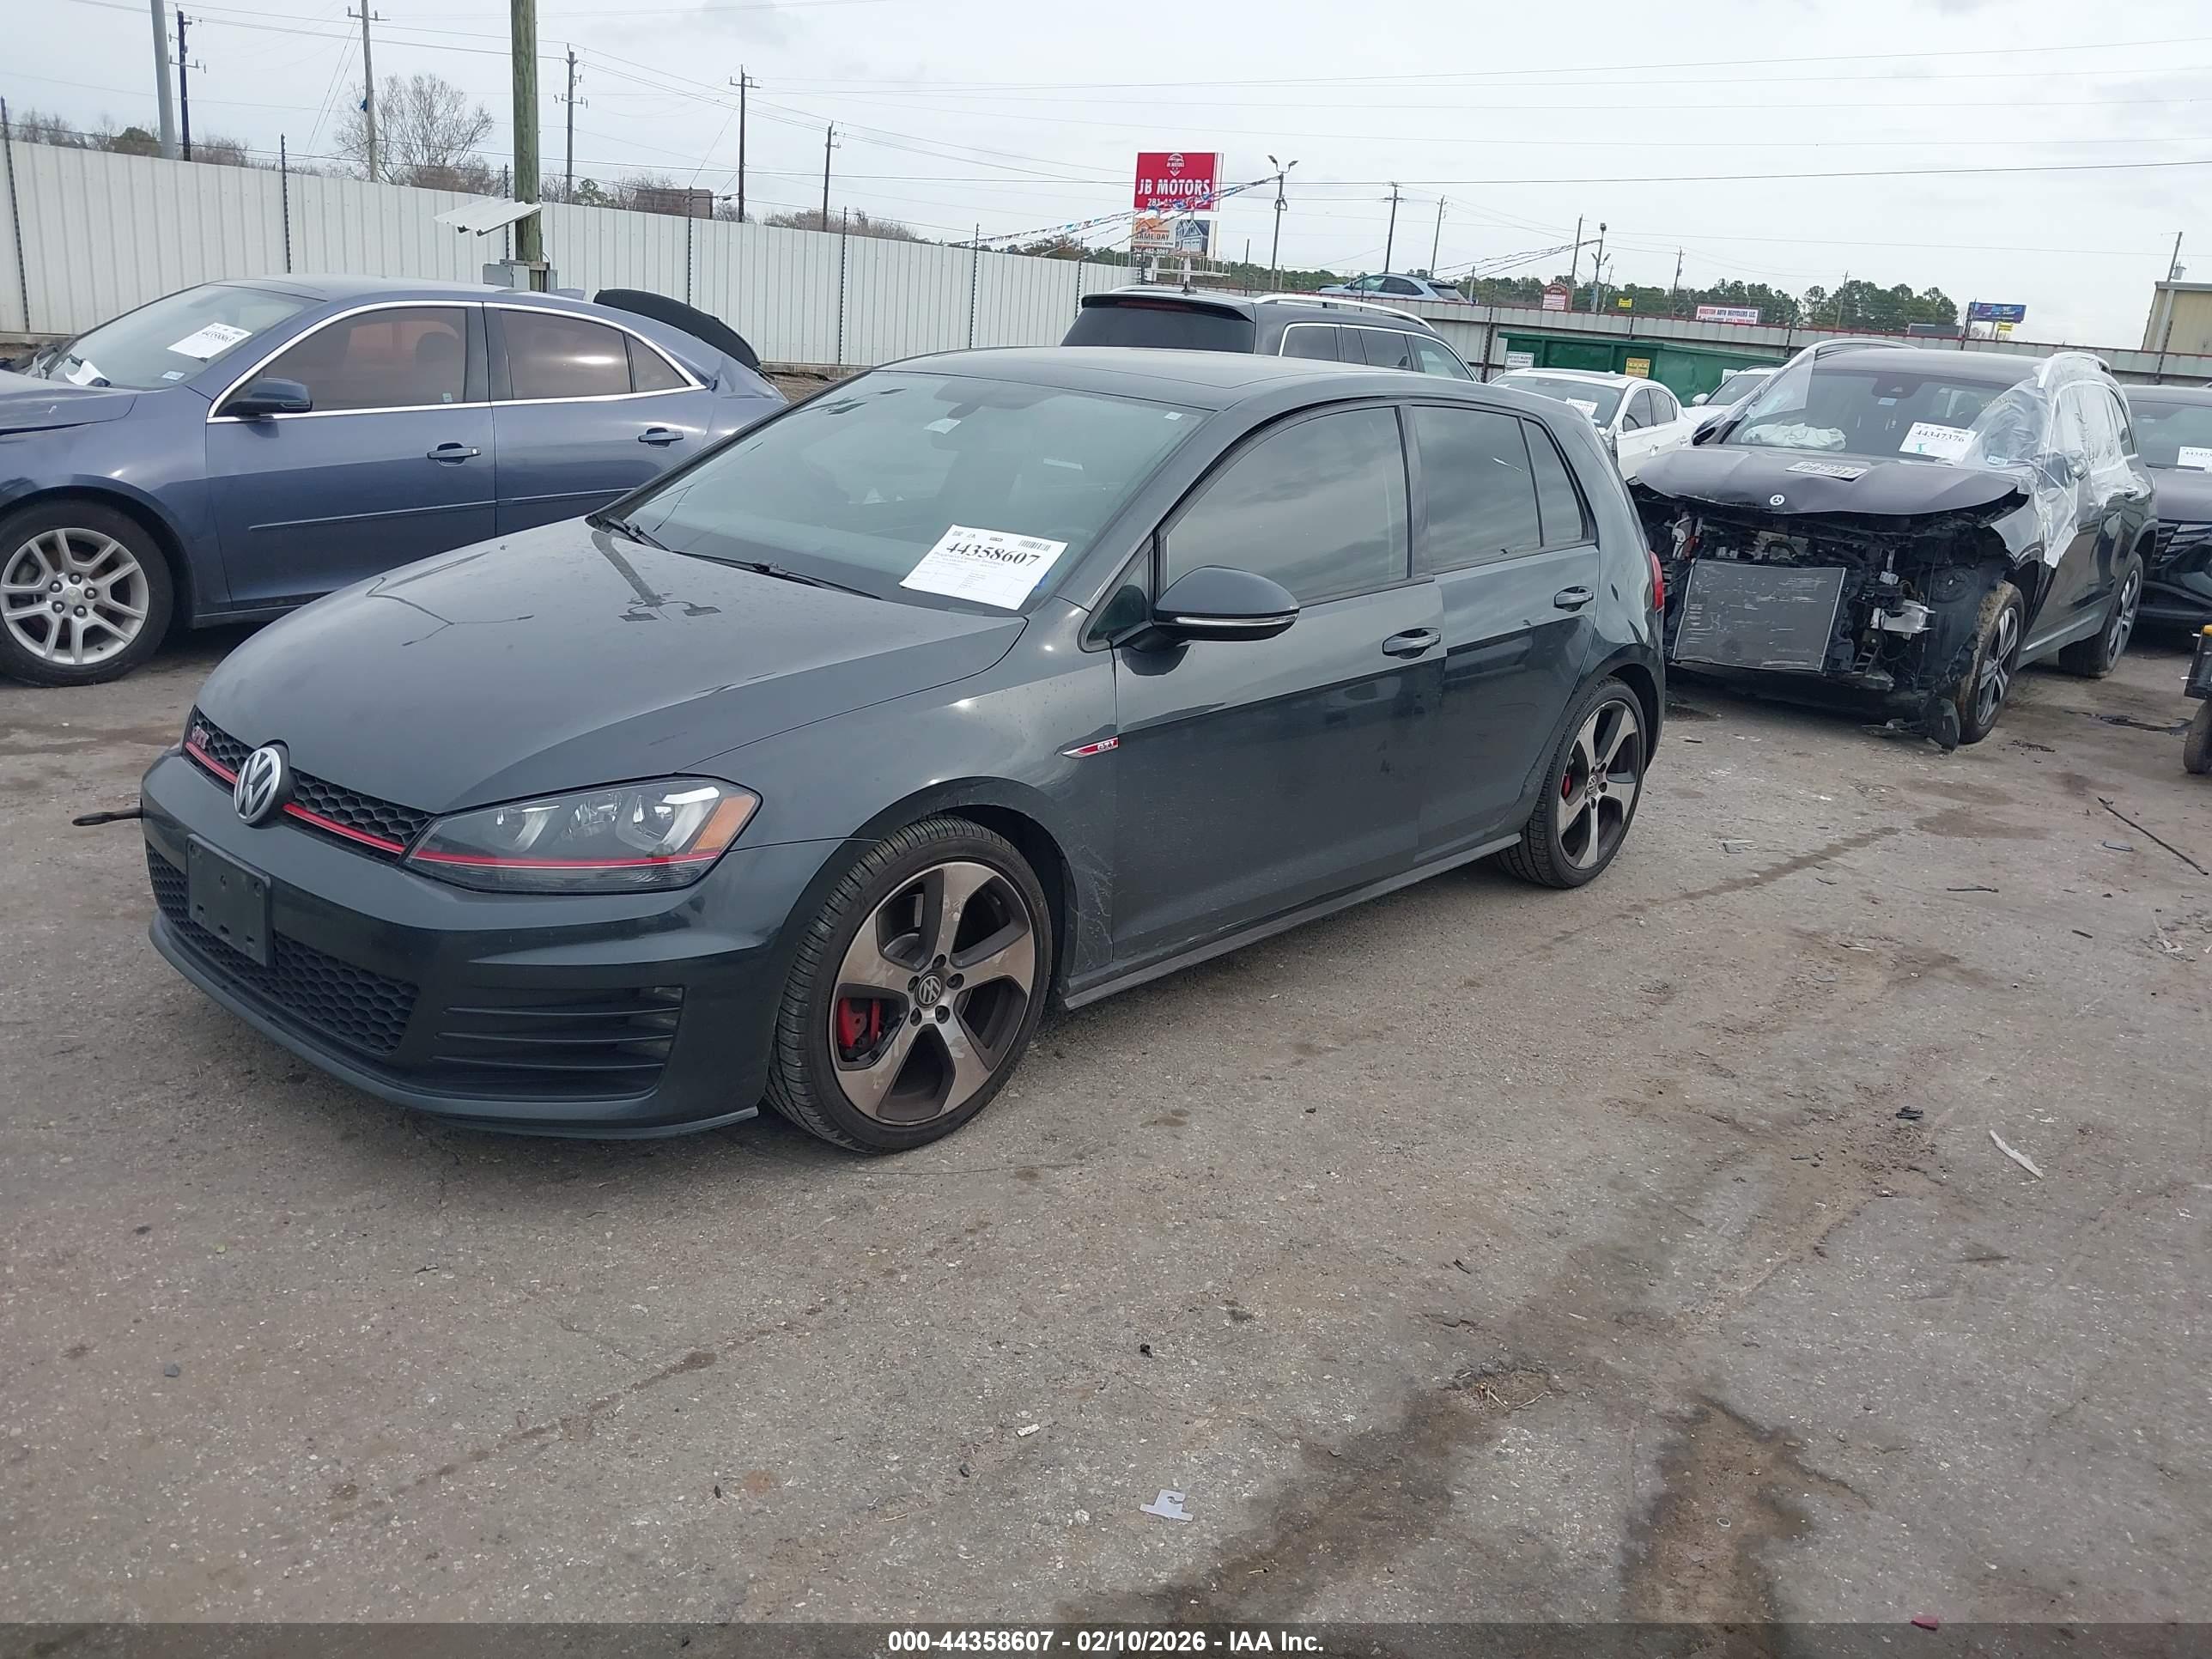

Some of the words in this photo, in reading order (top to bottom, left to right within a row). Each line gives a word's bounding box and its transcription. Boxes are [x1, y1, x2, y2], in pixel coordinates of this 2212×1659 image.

[1138, 179, 1153, 195] JB
[1157, 179, 1211, 196] MOTORS
[1134, 232, 1156, 241] SAME
[1156, 233, 1170, 241] DAY
[1915, 429, 1965, 442] 44347376
[946, 542, 1041, 567] 44358607
